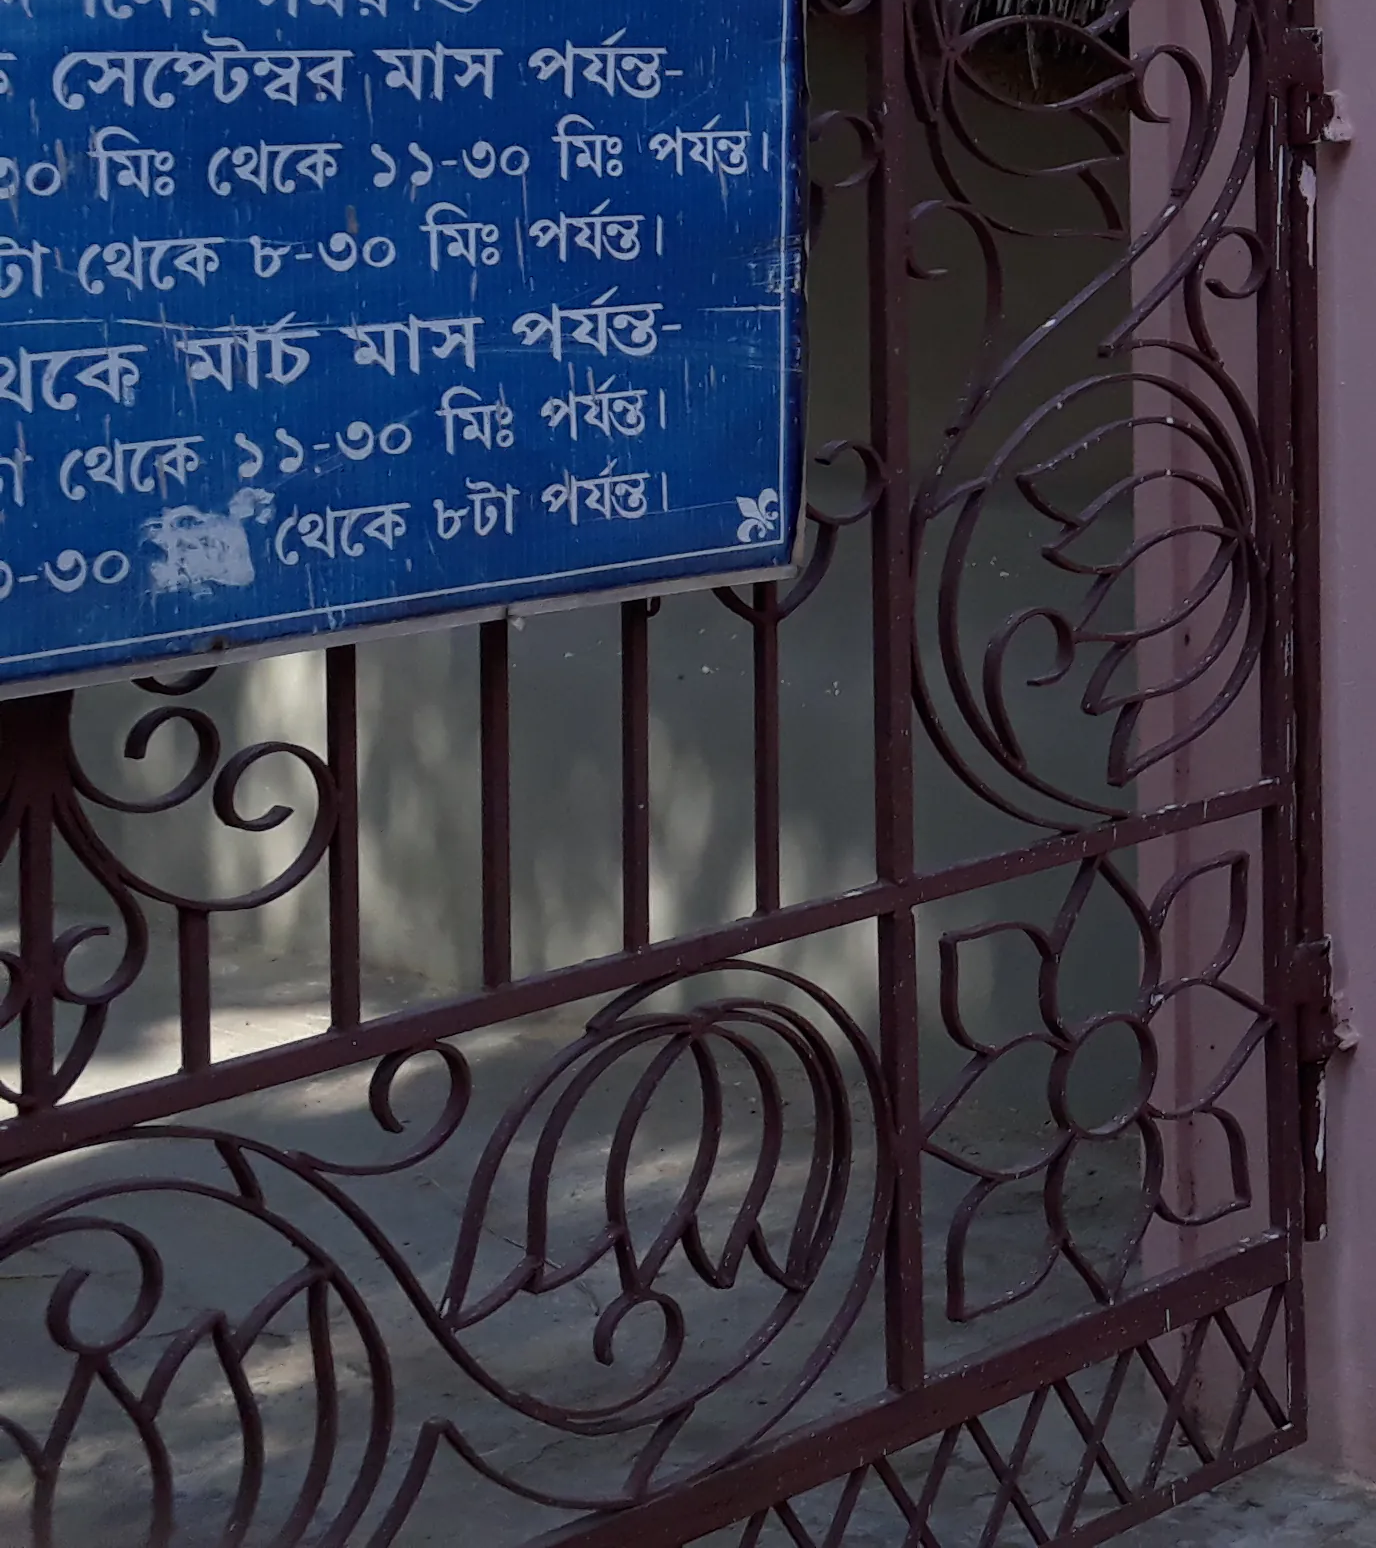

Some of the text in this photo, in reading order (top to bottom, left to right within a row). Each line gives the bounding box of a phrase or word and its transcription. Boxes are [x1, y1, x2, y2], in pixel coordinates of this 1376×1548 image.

[52, 30, 353, 110] সেপ্টেম্বর
[373, 40, 505, 102] মাস
[87, 126, 175, 202] মিঃ
[208, 142, 345, 198] থেকে
[371, 138, 531, 190] ১১-৩০
[552, 113, 624, 181] মিঃ
[78, 236, 225, 295] থেকে
[249, 233, 396, 281] ৮-৩০
[420, 201, 501, 272] মিঃ
[175, 311, 321, 392] মার্চ
[337, 313, 485, 376] মাস
[60, 435, 205, 501] থেকে
[235, 421, 412, 479] ১১-৩০
[436, 387, 515, 456] মিঃ
[274, 502, 411, 567] থেকে
[434, 478, 519, 542] ৮টা
